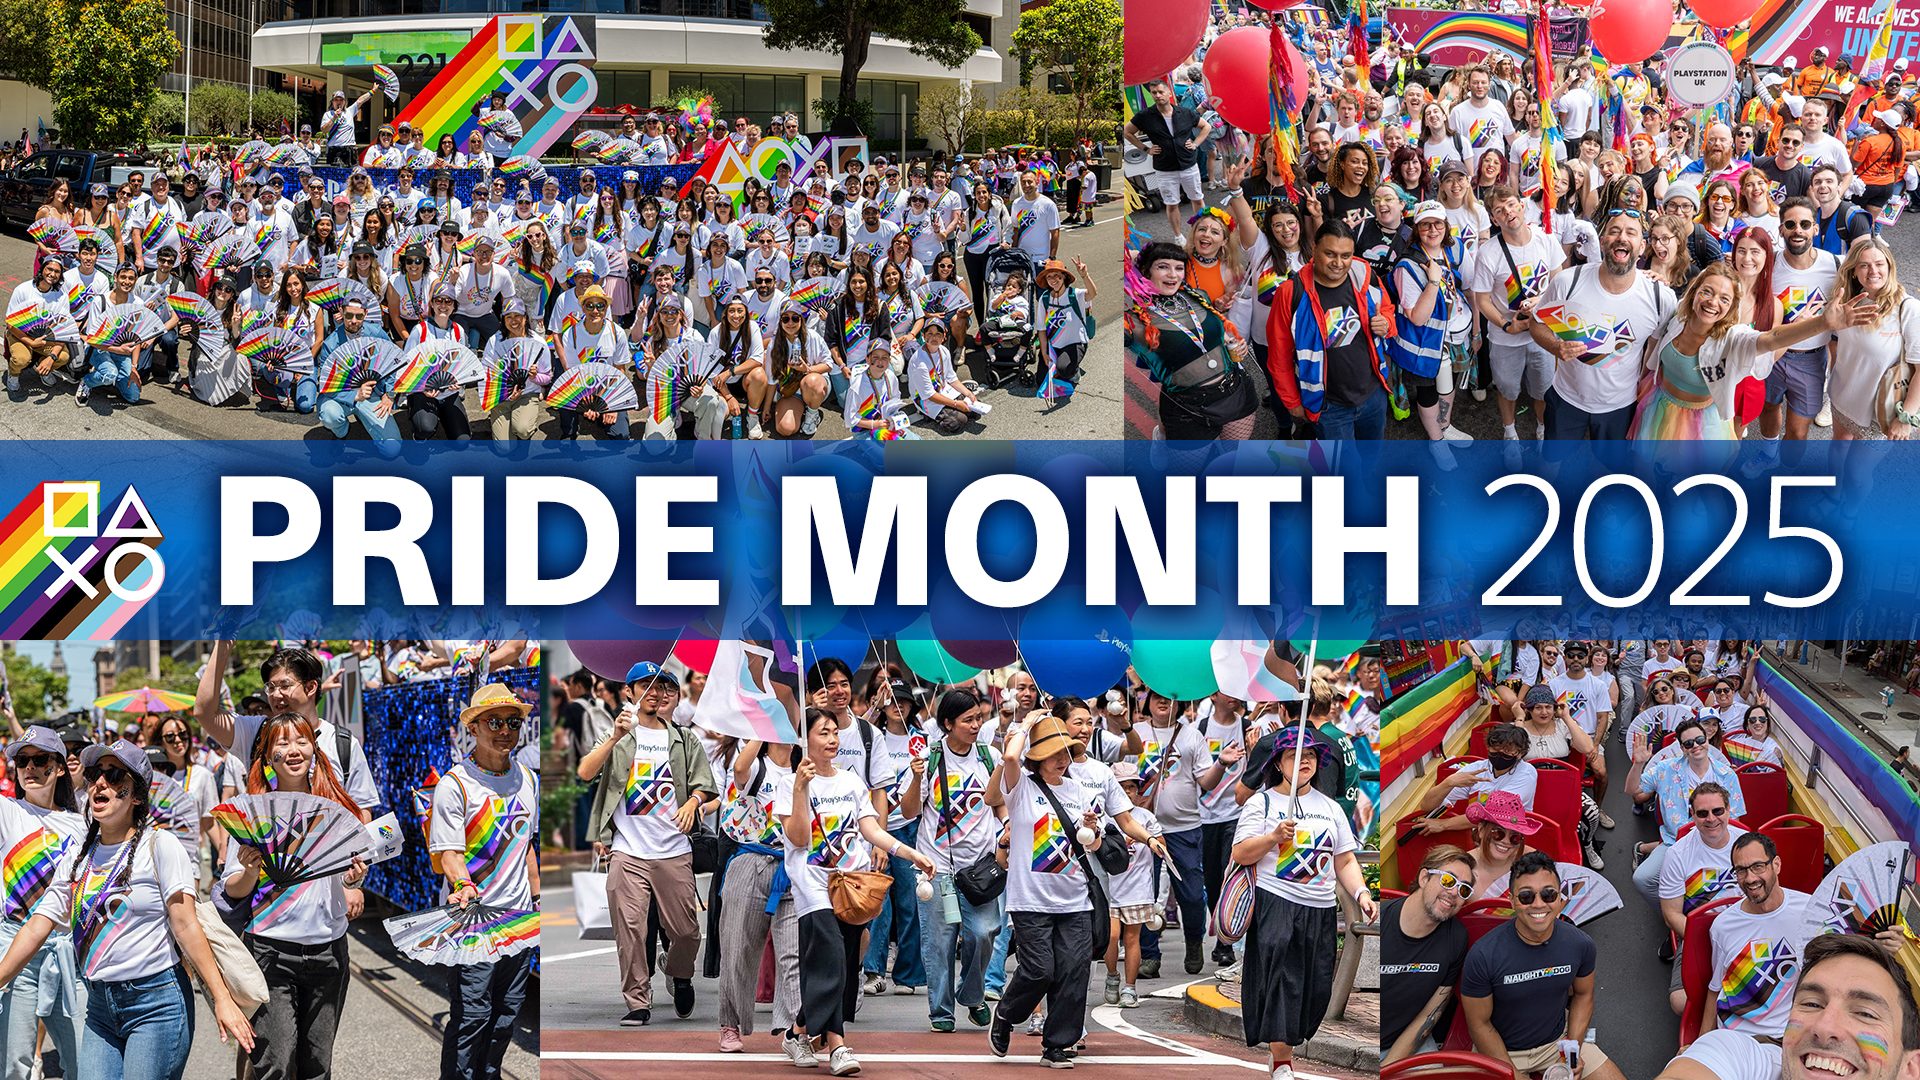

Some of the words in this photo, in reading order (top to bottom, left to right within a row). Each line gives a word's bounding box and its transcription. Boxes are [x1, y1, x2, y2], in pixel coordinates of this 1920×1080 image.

[1834, 5, 1855, 23] WE
[1855, 6, 1885, 25] ARE
[396, 53, 446, 78] 221
[646, 663, 657, 673] LA
[638, 744, 669, 753] PlayStat
[1380, 964, 1411, 974] UGHTY
[1420, 964, 1439, 972] DOG
[1505, 968, 1546, 984] NAUGHTY
[1553, 965, 1571, 975] DOG
